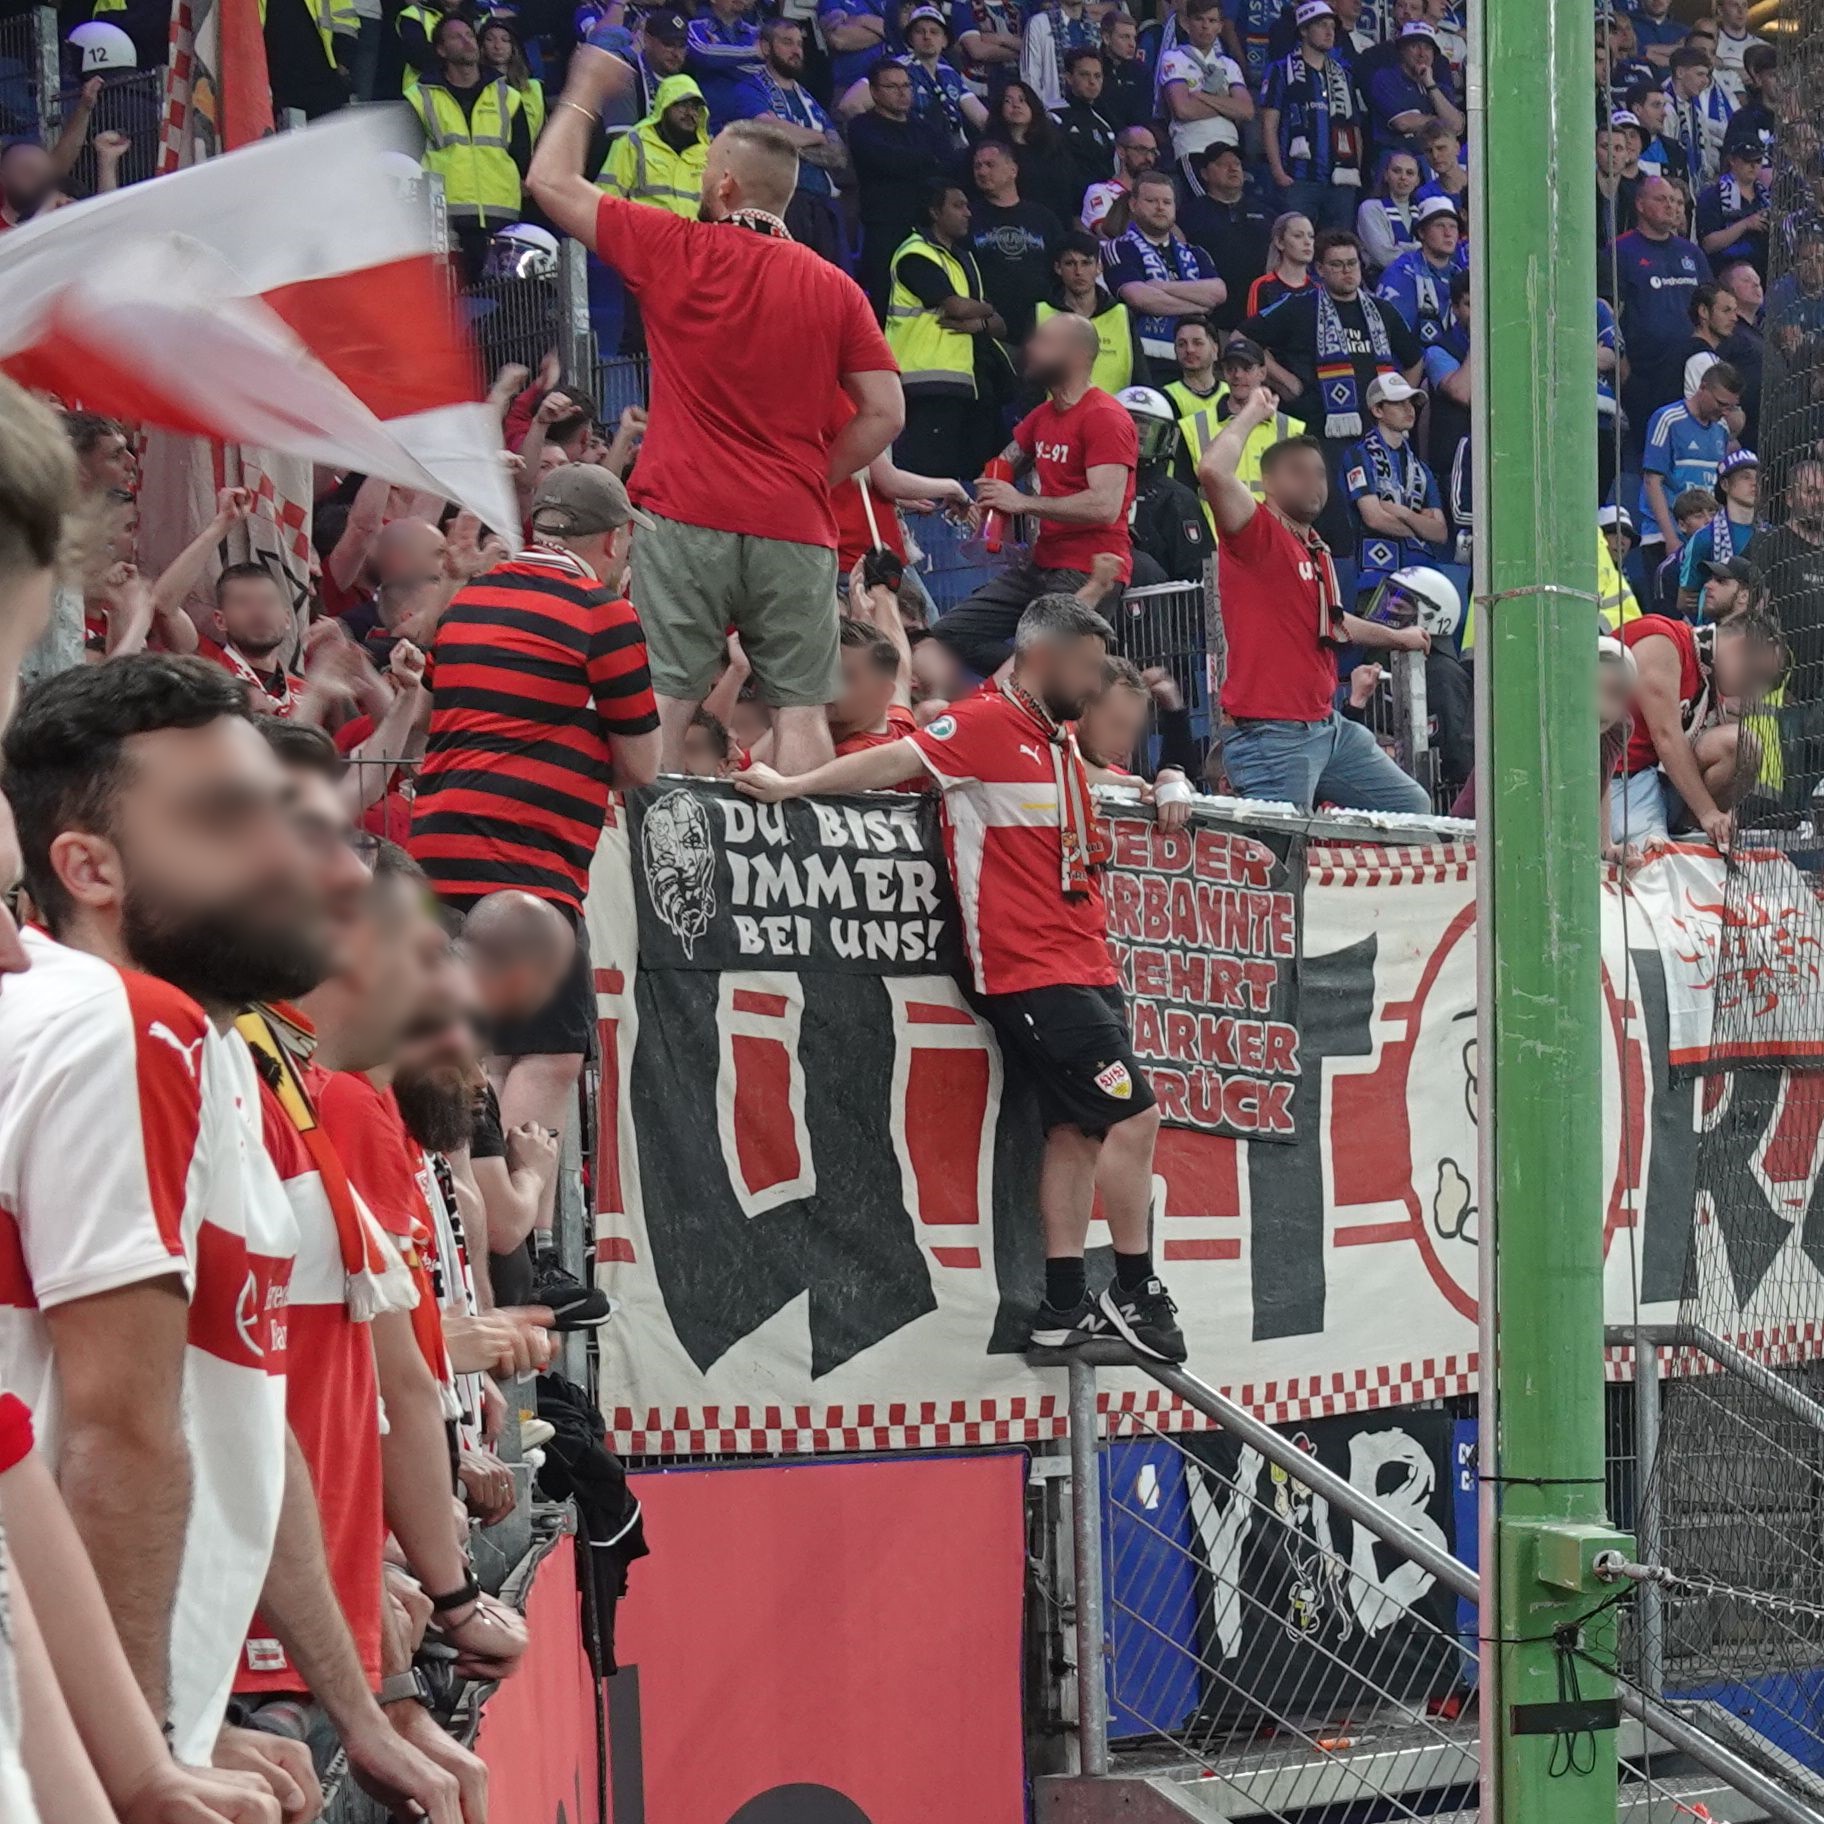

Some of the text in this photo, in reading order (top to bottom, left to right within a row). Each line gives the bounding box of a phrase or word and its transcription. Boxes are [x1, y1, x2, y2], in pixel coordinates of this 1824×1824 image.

[88, 47, 108, 63] 12
[1437, 617, 1452, 635] 12
[724, 799, 924, 852] DU BIST
[730, 853, 942, 911] IMMER
[737, 914, 946, 962] BEI UNS!
[1104, 871, 1296, 958] RBANNTE
